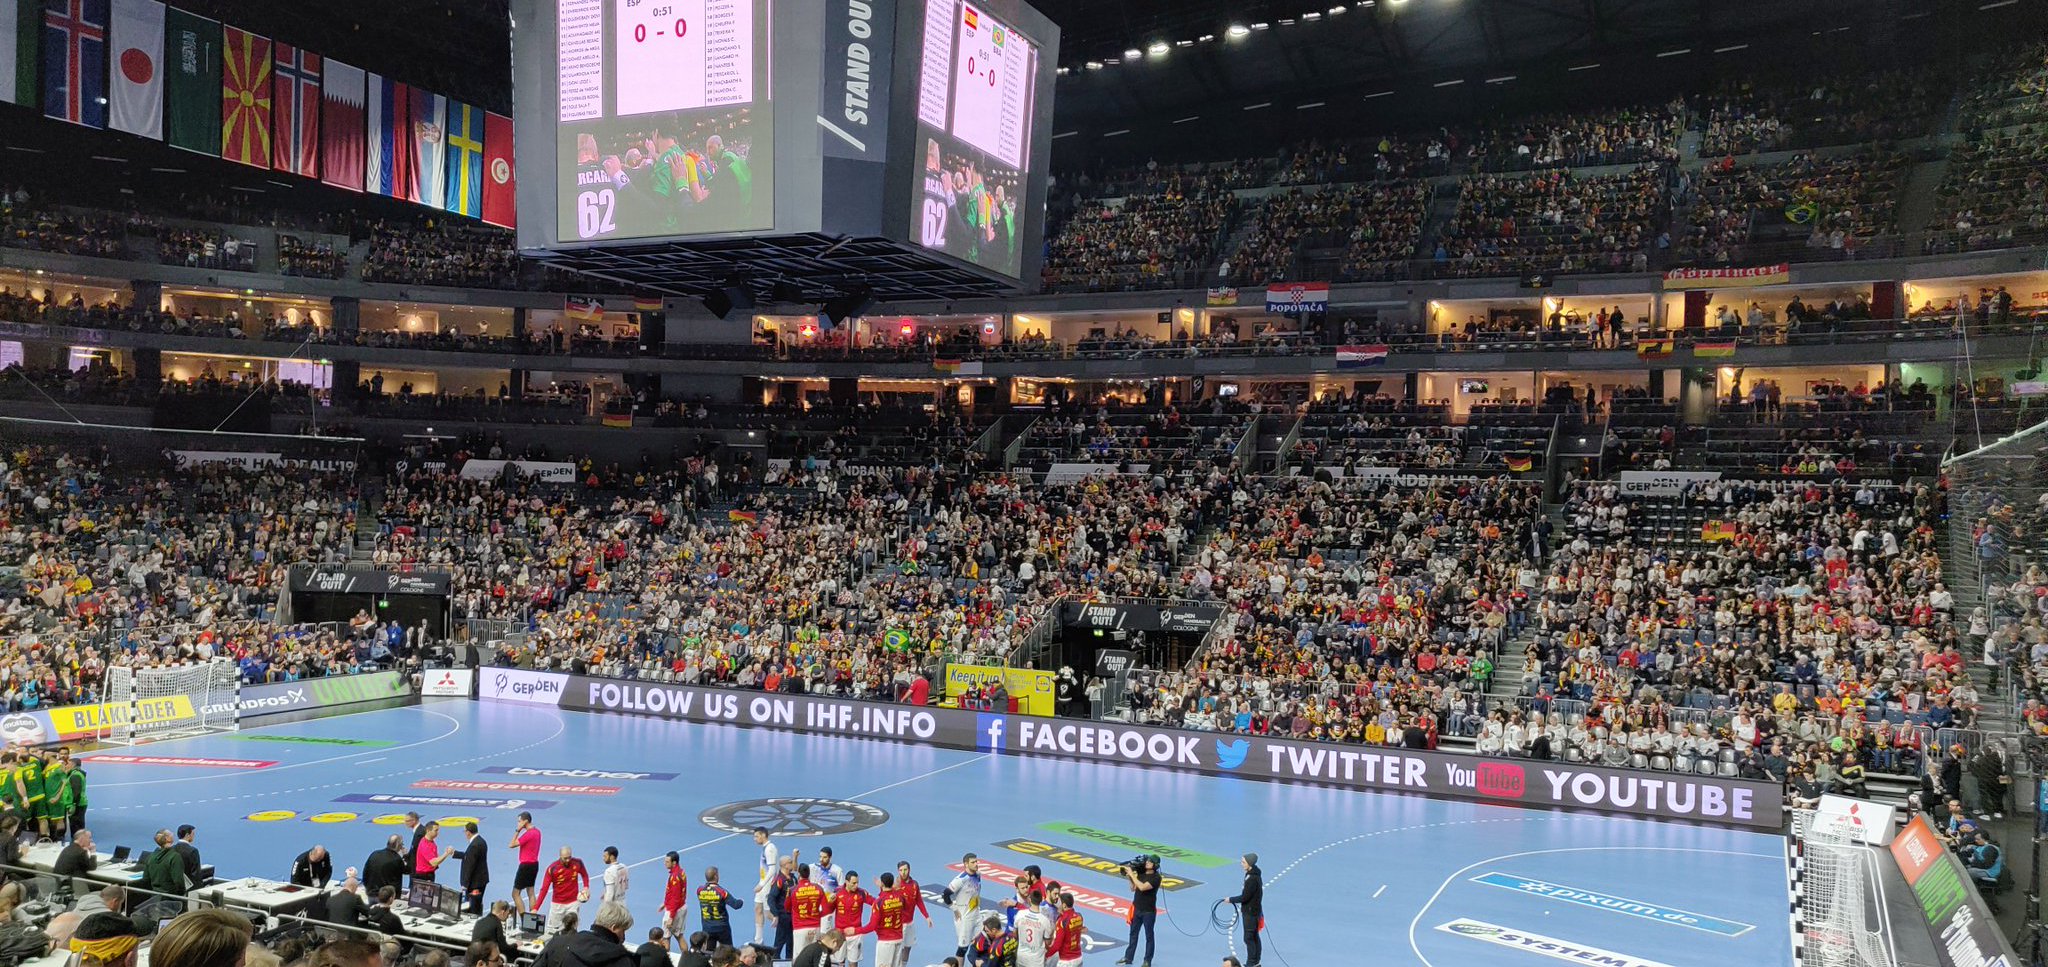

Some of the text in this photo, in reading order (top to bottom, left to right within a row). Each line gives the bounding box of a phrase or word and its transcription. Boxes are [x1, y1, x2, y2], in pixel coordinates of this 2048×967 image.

[652, 6, 672, 17] 0:51
[634, 24, 646, 43] 0
[675, 18, 687, 38] 0
[844, 0, 873, 125] STAND OU
[968, 56, 975, 75] 0
[989, 69, 996, 87] 0
[577, 188, 616, 239] 62
[922, 198, 947, 247] 62
[1270, 303, 1324, 312] POPOVAČA
[1088, 606, 1117, 616] STAND
[1091, 616, 1113, 626] OUT!
[1103, 655, 1127, 664] STAND
[1106, 663, 1125, 671] OUT!
[950, 668, 976, 683] Keep
[978, 670, 985, 683] it
[200, 694, 290, 715] GRUNDFOS
[589, 682, 936, 738] FOLLOW US ON IHF.INFO
[3, 719, 36, 730] molten
[1019, 721, 1201, 765] FACEBOOK
[508, 767, 650, 780] brother
[1267, 744, 1427, 787] TWITTER
[1543, 770, 1753, 820] YOUTUBE
[1067, 827, 1193, 858] GoDaddy
[1547, 888, 1699, 924] pixum.de
[1025, 928, 1033, 943] 3
[1497, 933, 1628, 967] SYSTEM
